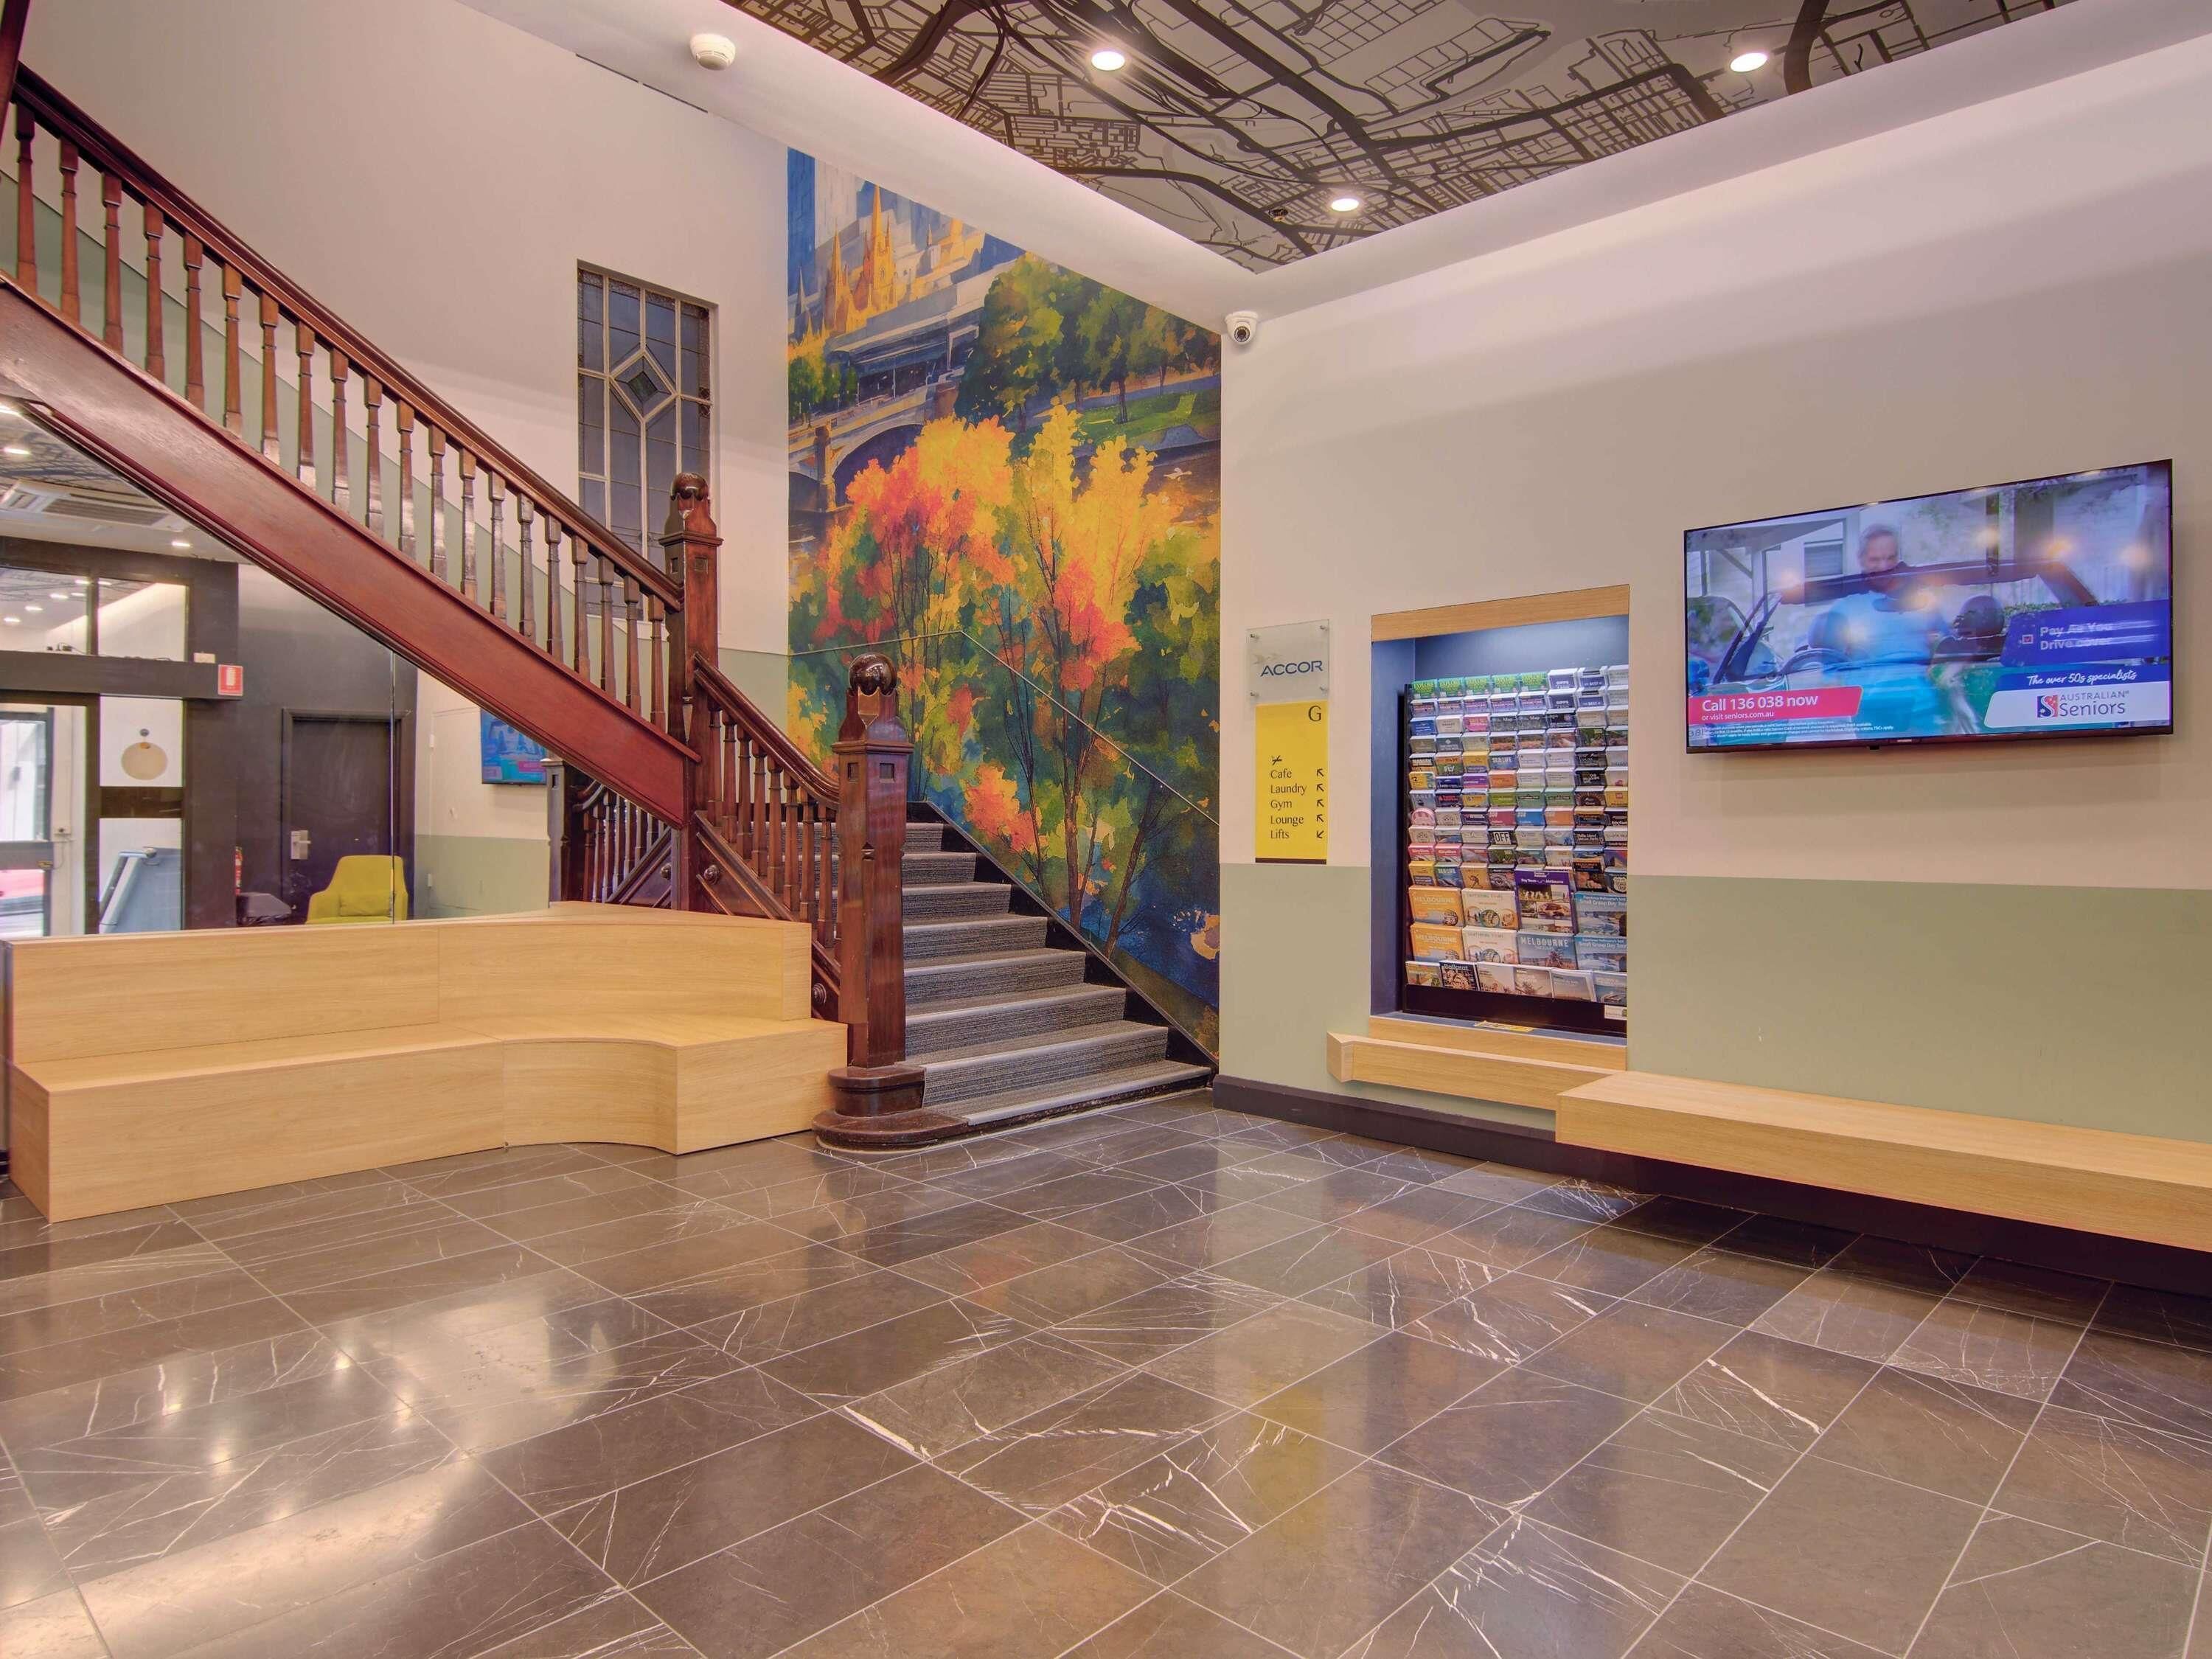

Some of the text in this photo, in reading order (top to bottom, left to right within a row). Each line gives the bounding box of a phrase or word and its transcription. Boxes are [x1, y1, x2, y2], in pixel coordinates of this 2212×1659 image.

[1260, 660, 1324, 677] ACCOR
[2027, 669, 2138, 686] The over 50s specialists
[2059, 691, 2126, 701] AUSTRALIAN
[1702, 695, 1818, 712] Call 136 038 now
[2059, 700, 2125, 717] Seniors
[1308, 706, 1322, 722] G
[1711, 712, 1724, 720] visit
[1725, 712, 1774, 720] seniors.com.au
[1270, 768, 1293, 779] Cafe
[1270, 783, 1307, 796] Laundry
[1270, 799, 1293, 810] Gym
[1270, 814, 1304, 827] Lounge
[1270, 829, 1290, 839] Lifts
[1494, 832, 1509, 842] OFF
[1520, 937, 1568, 947] MELBOURNE
